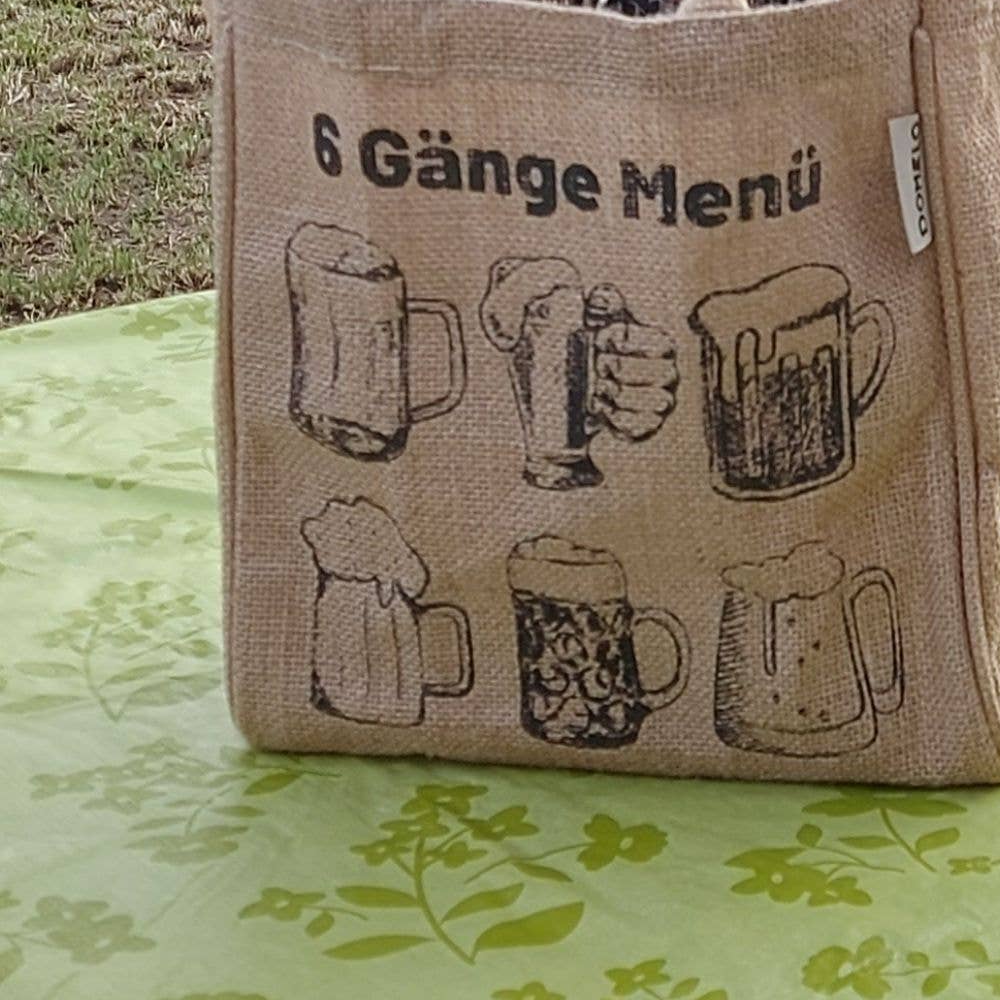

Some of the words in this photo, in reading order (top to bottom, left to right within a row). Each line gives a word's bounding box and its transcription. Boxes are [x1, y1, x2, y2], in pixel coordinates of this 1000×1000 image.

[312, 112, 342, 177] 6
[358, 128, 602, 217] Gänge
[619, 144, 822, 228] Menü
[911, 122, 929, 237] DOMELO
